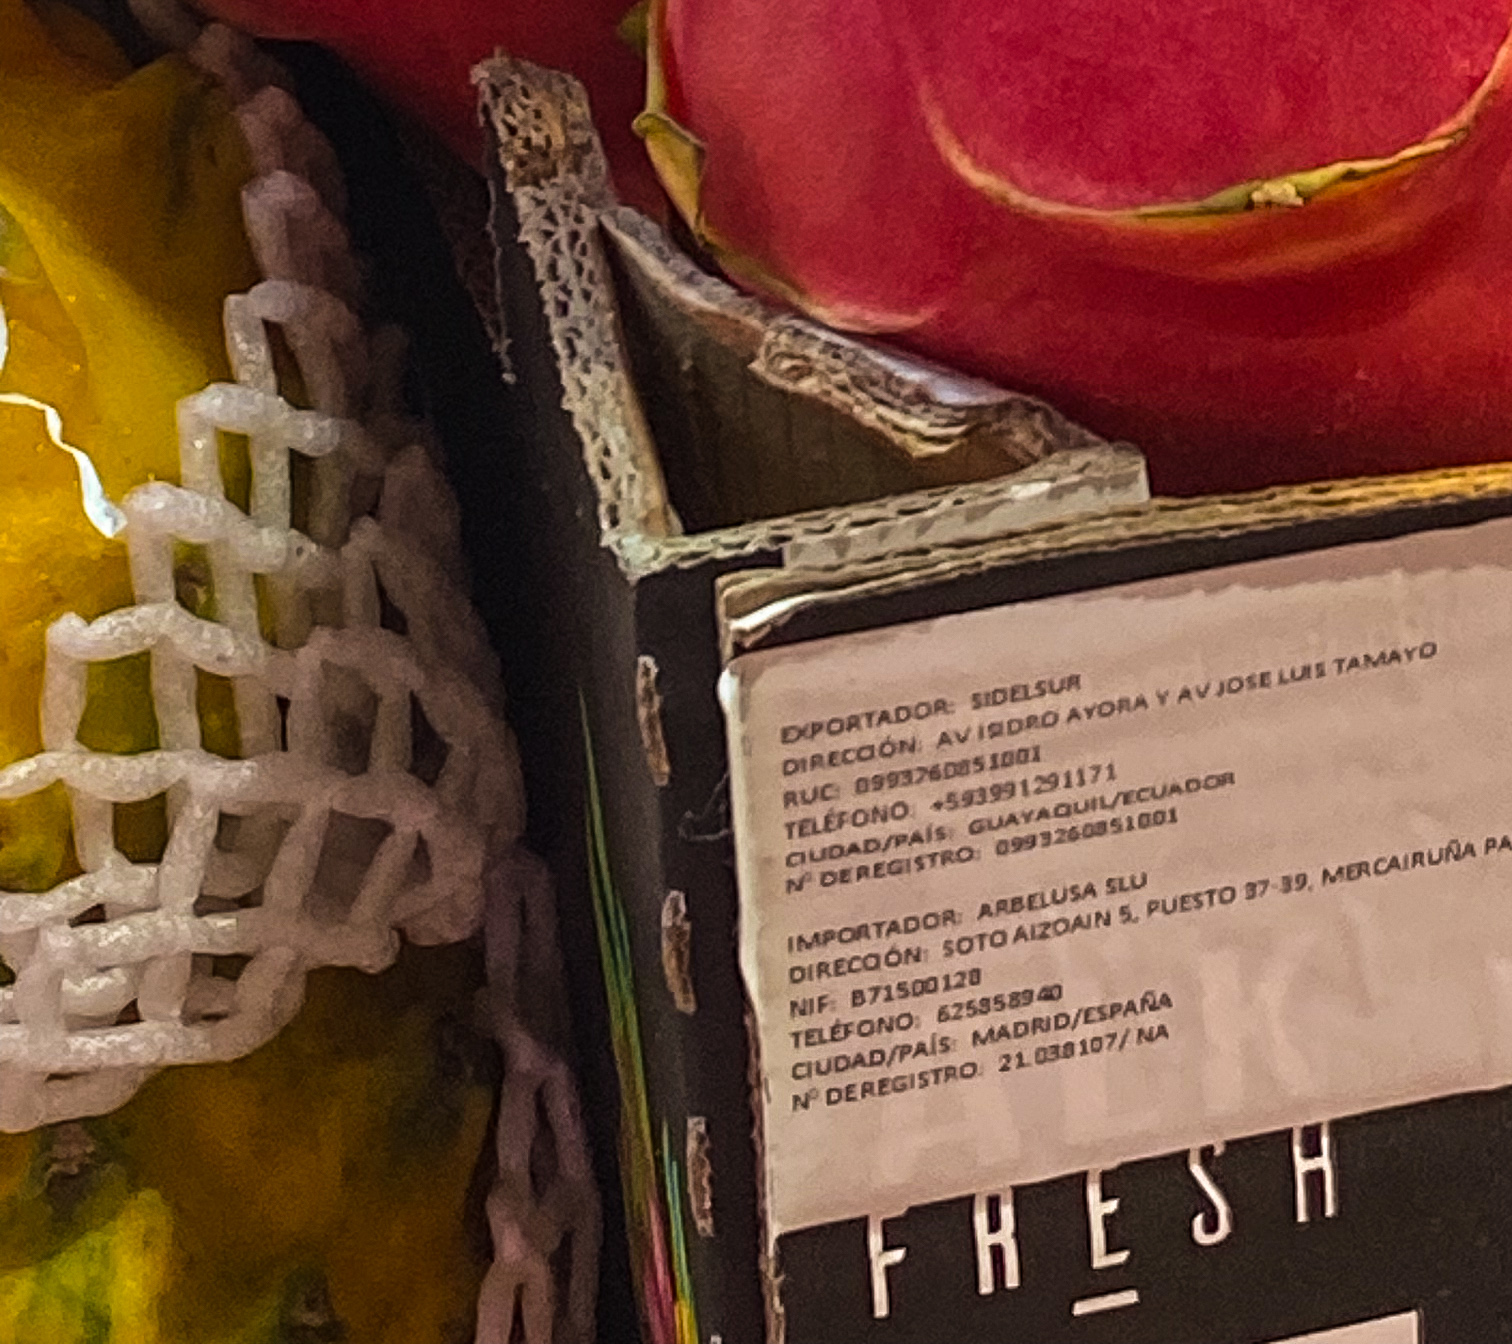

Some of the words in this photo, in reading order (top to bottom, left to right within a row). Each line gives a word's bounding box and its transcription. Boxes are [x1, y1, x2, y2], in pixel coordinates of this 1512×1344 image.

[780, 698, 956, 745] EXPORTADOR:
[971, 674, 1081, 711] SIDELSUR
[782, 735, 922, 777] DIRECCIÓN:
[1066, 693, 1149, 723] AYORA
[1155, 689, 1170, 706] Y
[1213, 670, 1272, 698] JOSE
[1278, 661, 1328, 686] LUIS
[1333, 641, 1438, 675] TAMAYO
[782, 783, 839, 809] RUC:
[967, 772, 1236, 835] GUAYAQUIL/ECUADOR
[787, 908, 963, 954] IMPORTADOR:
[976, 881, 1098, 922] ARBELUSA
[1105, 871, 1149, 895] SLU
[788, 944, 929, 984] DIRECCIÓN:
[943, 929, 1008, 958] SOTO
[1012, 909, 1112, 944] AIZOAIN
[1146, 885, 1237, 918] PUESTO
[1321, 838, 1478, 888] MERCAIRUÑA
[971, 989, 1174, 1048] MADRID/ESPAÑA
[866, 1120, 1339, 1319] FRESH
